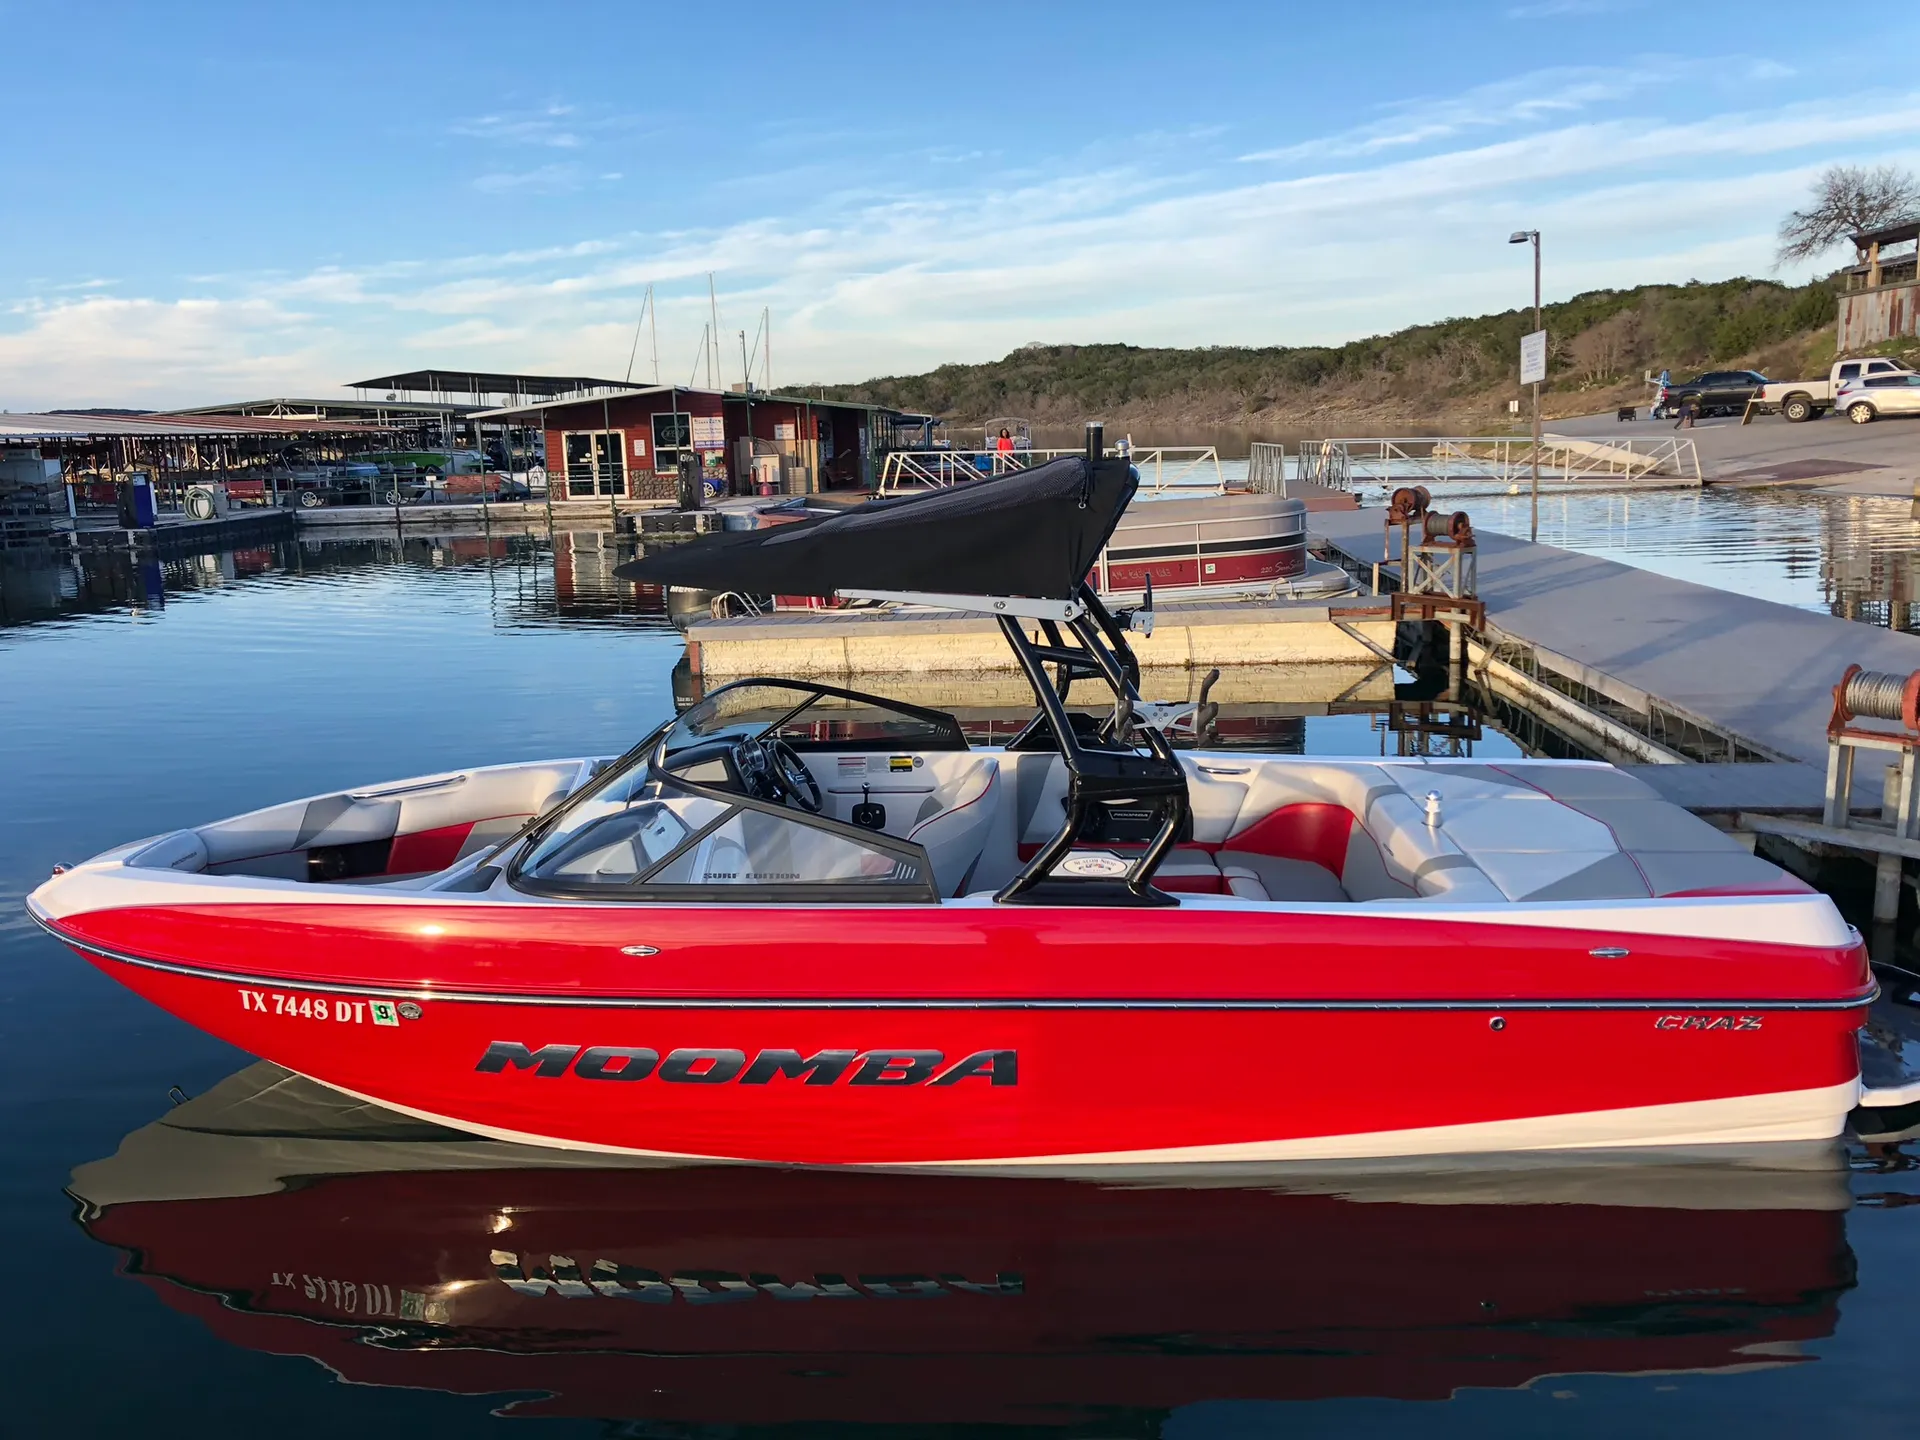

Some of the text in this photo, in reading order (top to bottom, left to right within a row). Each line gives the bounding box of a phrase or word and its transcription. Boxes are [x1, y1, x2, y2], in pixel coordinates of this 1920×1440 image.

[238, 989, 367, 1024] TX 7448 DT
[378, 1004, 390, 1020] 9
[1654, 1014, 1764, 1031] CRAZ
[473, 1040, 1018, 1087] MOOMBA
